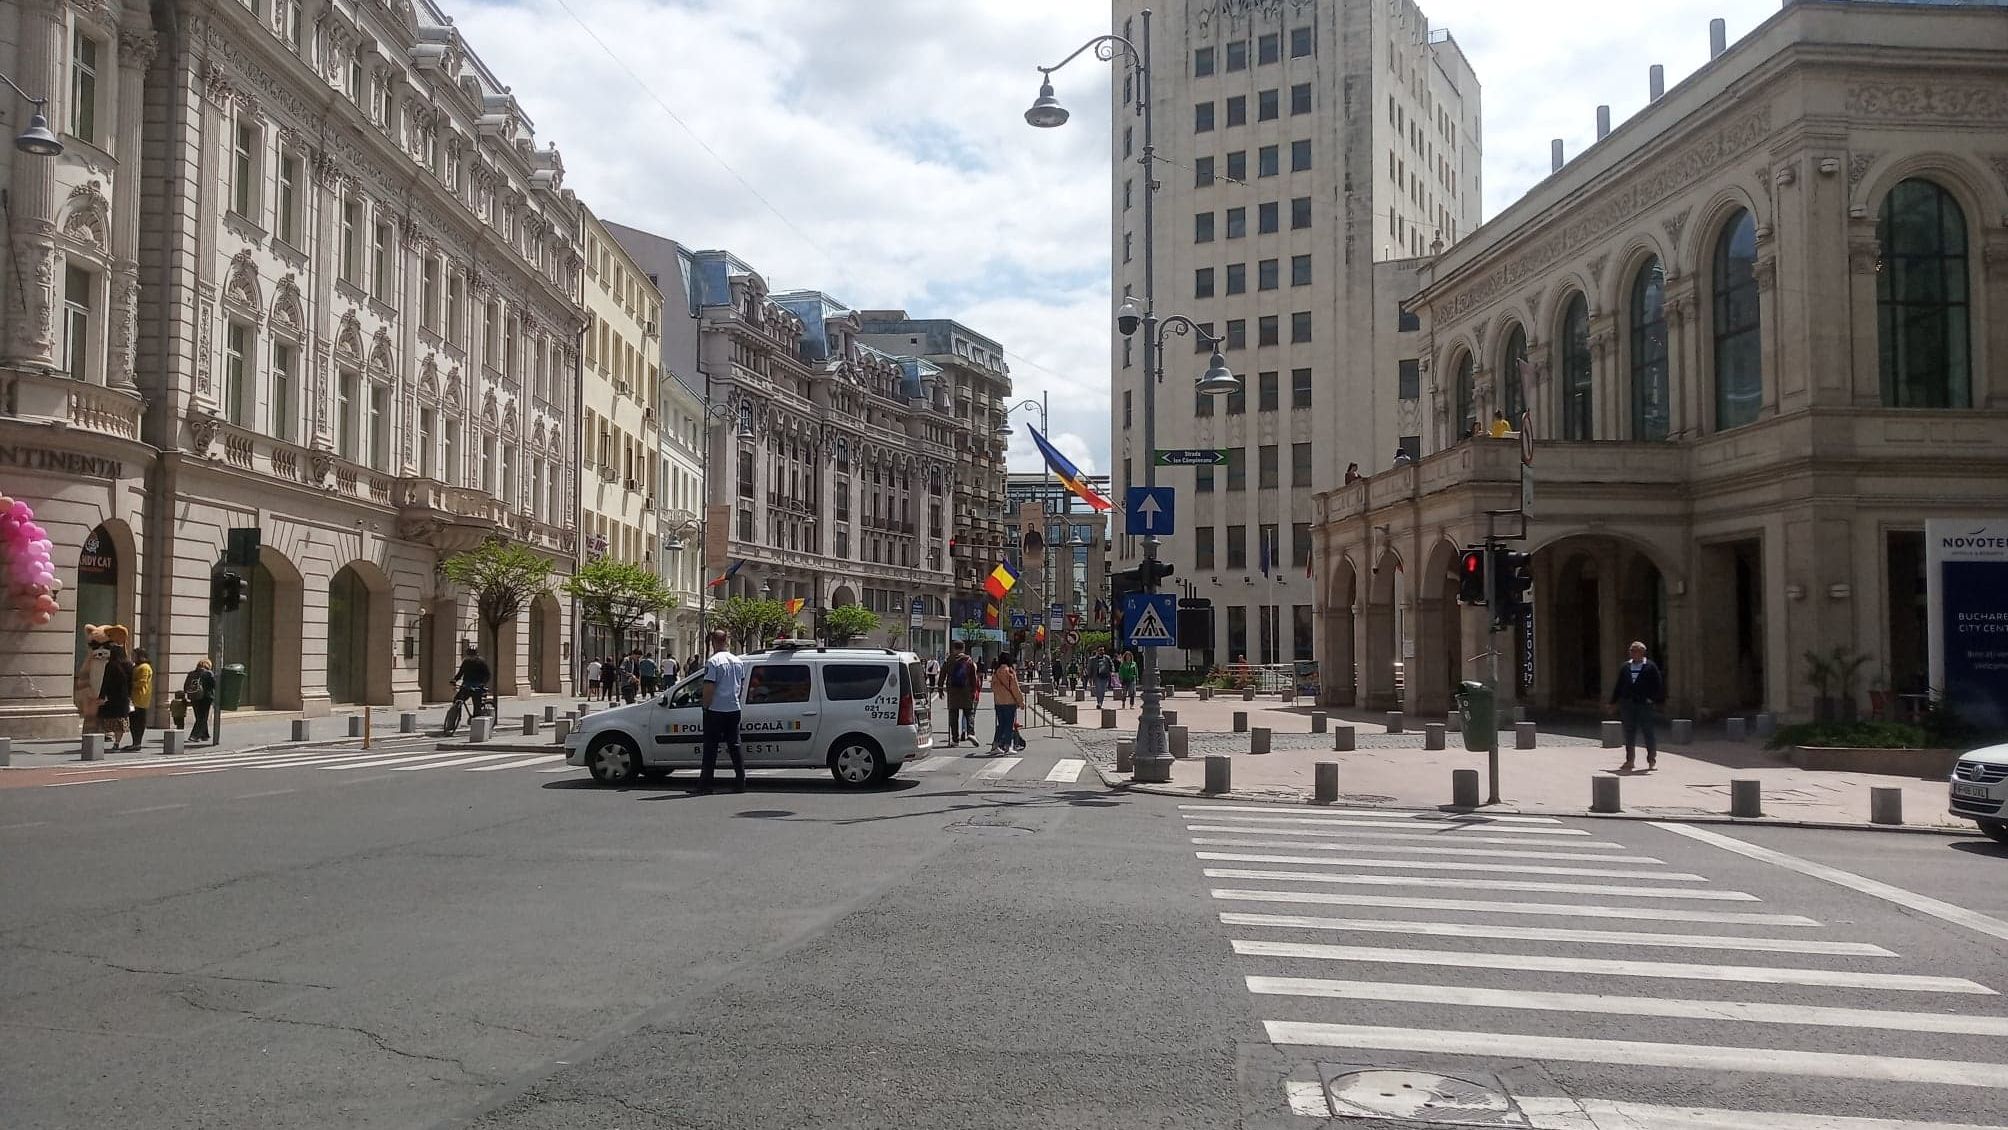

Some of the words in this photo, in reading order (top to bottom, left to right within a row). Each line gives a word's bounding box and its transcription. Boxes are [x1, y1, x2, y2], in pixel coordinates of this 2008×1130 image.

[1942, 537, 2008, 548] NOVOTE
[1959, 624, 1981, 633] CITY
[880, 696, 898, 705] 112
[871, 711, 897, 720] 9752
